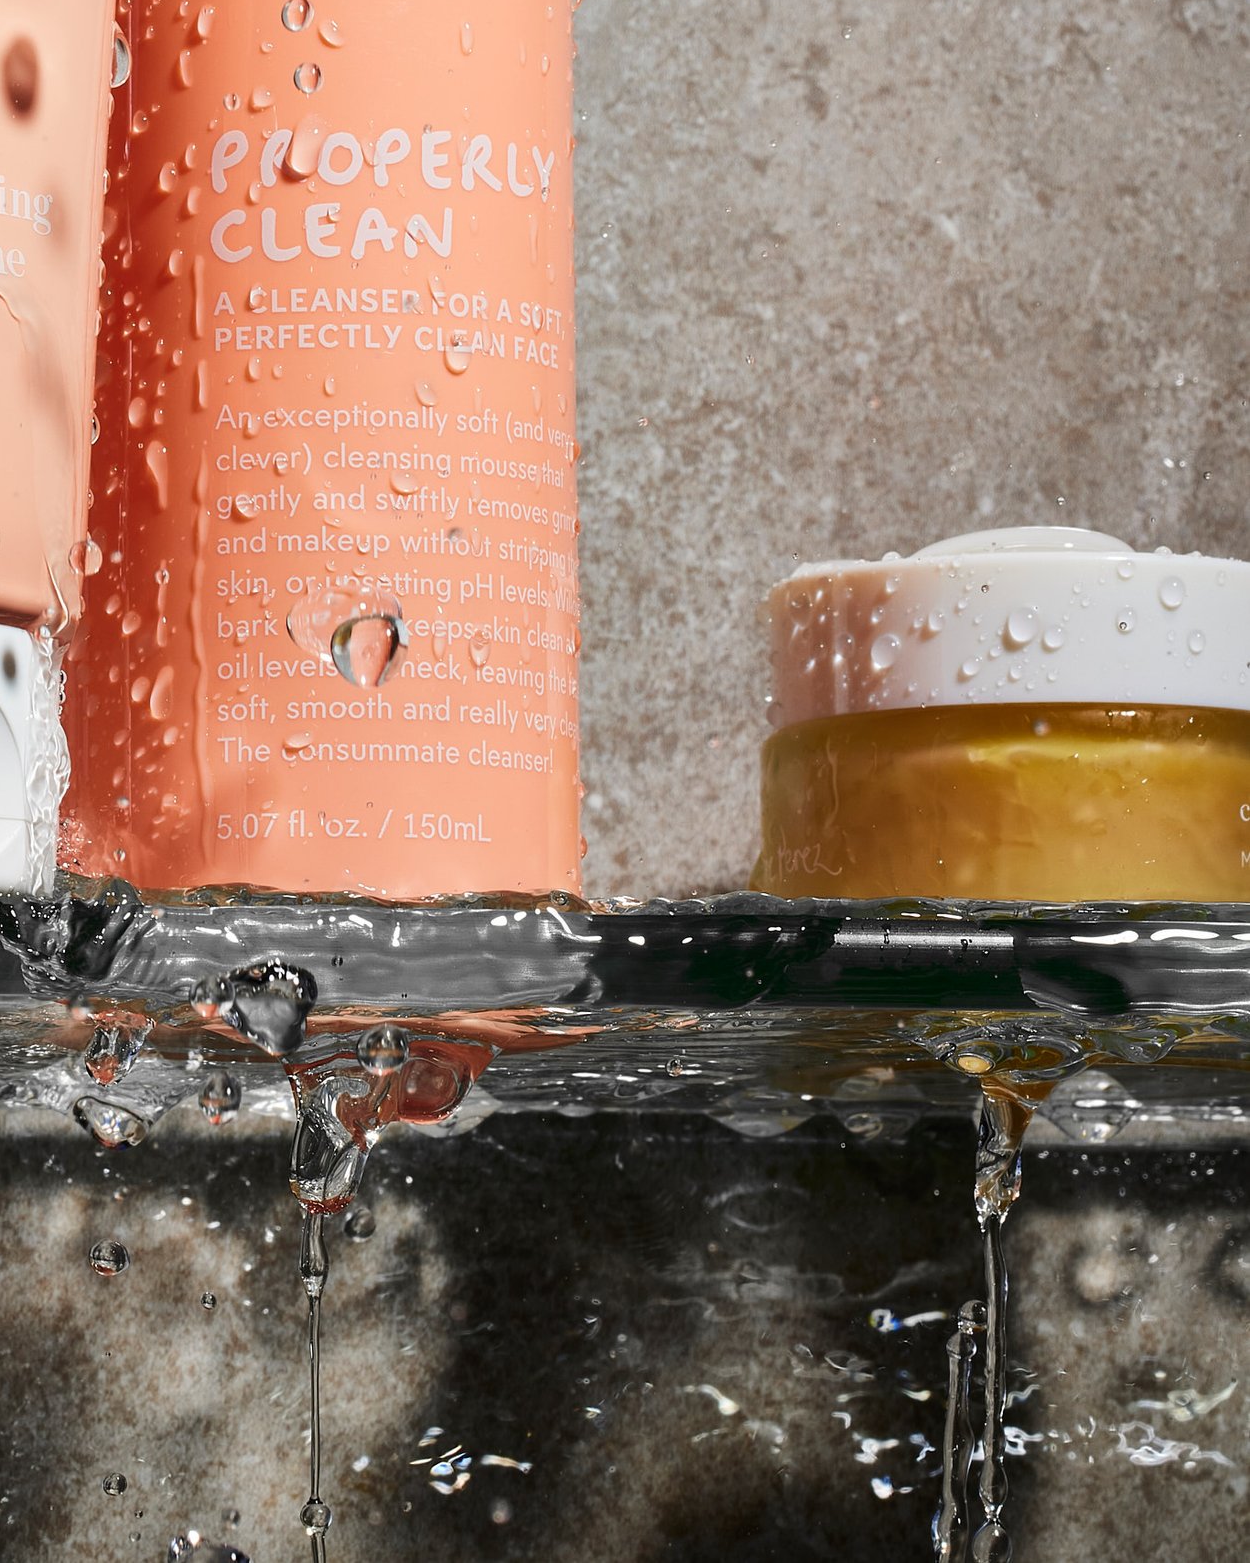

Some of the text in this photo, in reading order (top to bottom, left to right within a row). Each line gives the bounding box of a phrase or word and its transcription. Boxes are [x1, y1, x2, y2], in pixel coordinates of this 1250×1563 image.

[211, 128, 555, 200] PROPERLY
[210, 202, 452, 263] CLEAN
[214, 292, 236, 317] A
[250, 287, 423, 315] CLEANSER
[432, 290, 489, 320] FOR
[496, 298, 513, 324] A
[215, 324, 559, 369] PERFECTLY CLEAN FACE
[215, 404, 253, 430] An
[263, 401, 448, 437] exceptionally
[456, 409, 499, 435] soft
[506, 411, 544, 444] (and
[216, 442, 565, 489] clever) cleansing mousse that
[216, 485, 301, 519] gently
[313, 484, 365, 511] and
[376, 486, 460, 520] swiftly
[468, 495, 548, 525] removes
[217, 527, 266, 554] and
[277, 525, 390, 558] makeup
[400, 527, 491, 558] without
[499, 537, 565, 577] stripping
[216, 569, 277, 598] skin,
[286, 575, 317, 594] or
[460, 574, 493, 607] pH
[500, 575, 551, 608] levels.
[217, 612, 278, 638] bark
[484, 615, 520, 644] skin
[527, 621, 564, 653] clean
[217, 652, 248, 679] oil
[259, 652, 338, 678] levels
[400, 653, 468, 685] neck,
[476, 659, 544, 696] leaving
[549, 665, 566, 695] the
[216, 694, 276, 724] soft,
[286, 695, 392, 721] smooth
[403, 695, 451, 722] and
[460, 698, 518, 734] really
[524, 710, 556, 741] very,
[217, 738, 553, 773] The consummate cleanser!
[216, 809, 492, 842] 5.07 fl. oz. / 150mL
